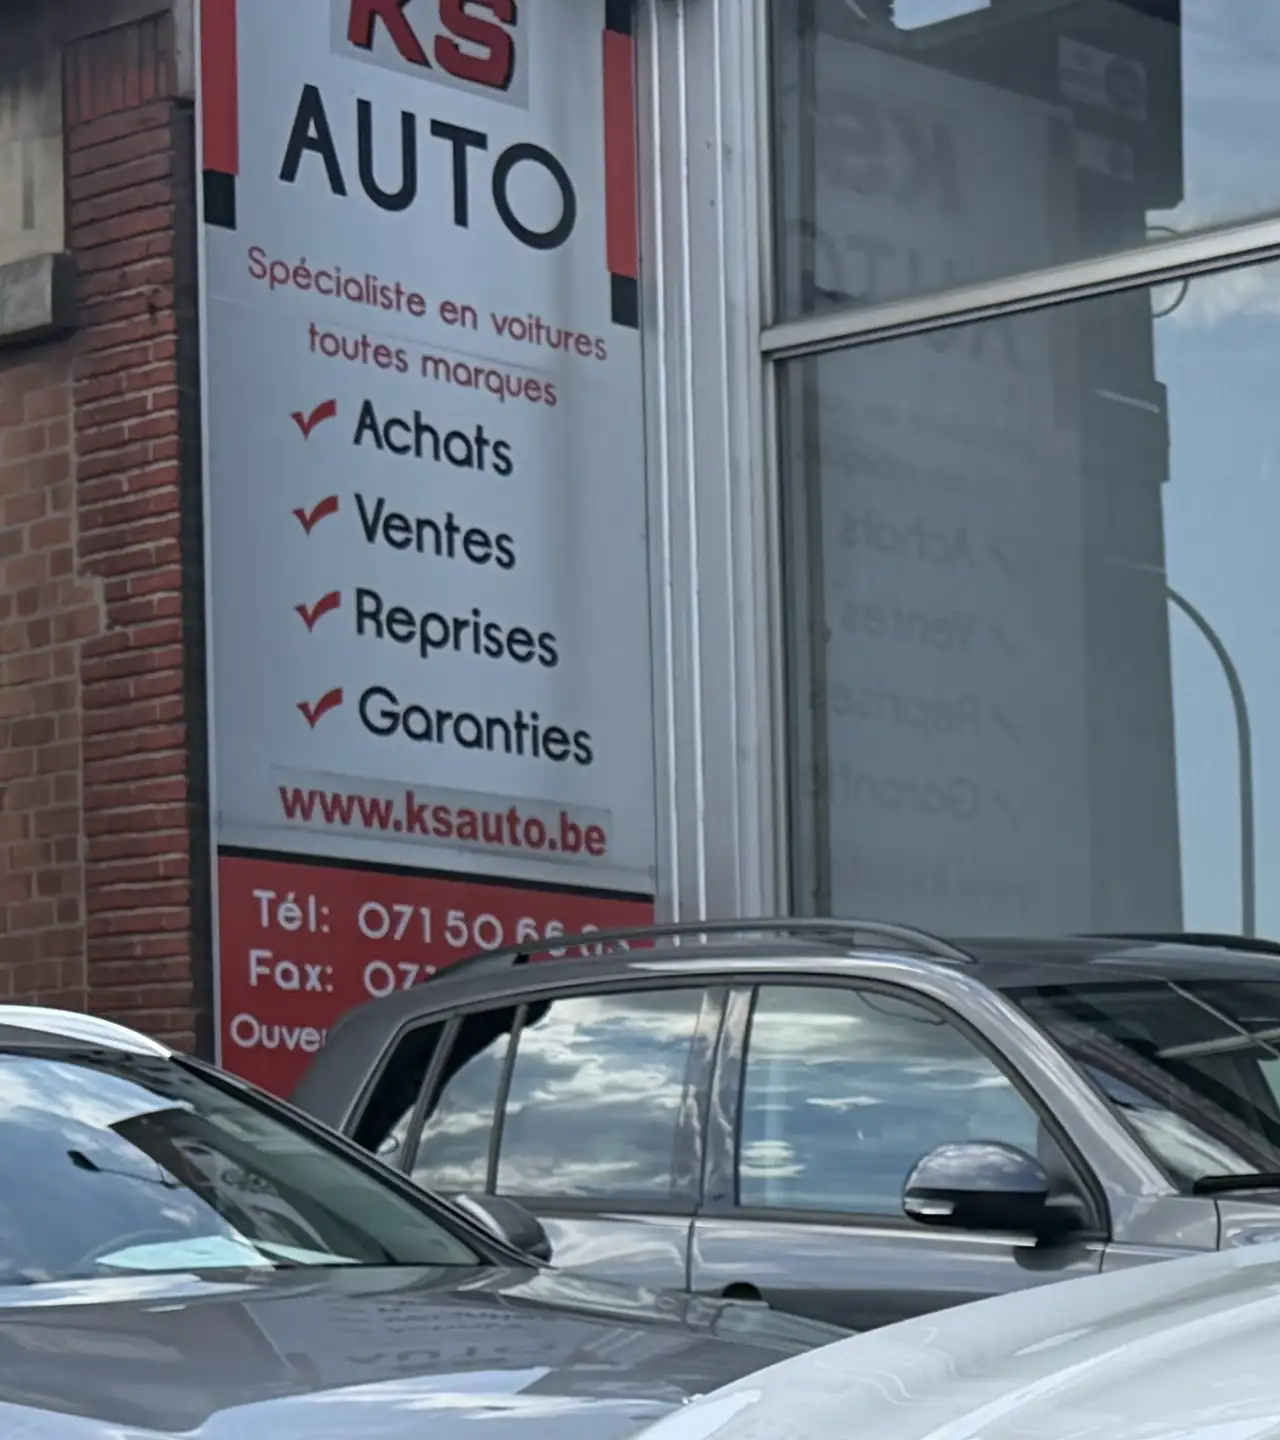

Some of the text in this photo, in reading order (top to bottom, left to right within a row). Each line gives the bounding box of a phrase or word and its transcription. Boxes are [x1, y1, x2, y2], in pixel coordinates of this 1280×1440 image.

[279, 84, 577, 250] AUTO
[247, 245, 608, 361] Spécialiste en voitures
[308, 322, 558, 407] toutes marques
[353, 399, 514, 477] Achats
[354, 492, 516, 570] Ventes
[355, 587, 559, 668] Reprises
[358, 686, 594, 766] Garanties
[278, 785, 607, 856] www.ksauto.be
[252, 889, 331, 934] Tél:
[249, 950, 437, 998] Fax: 07
